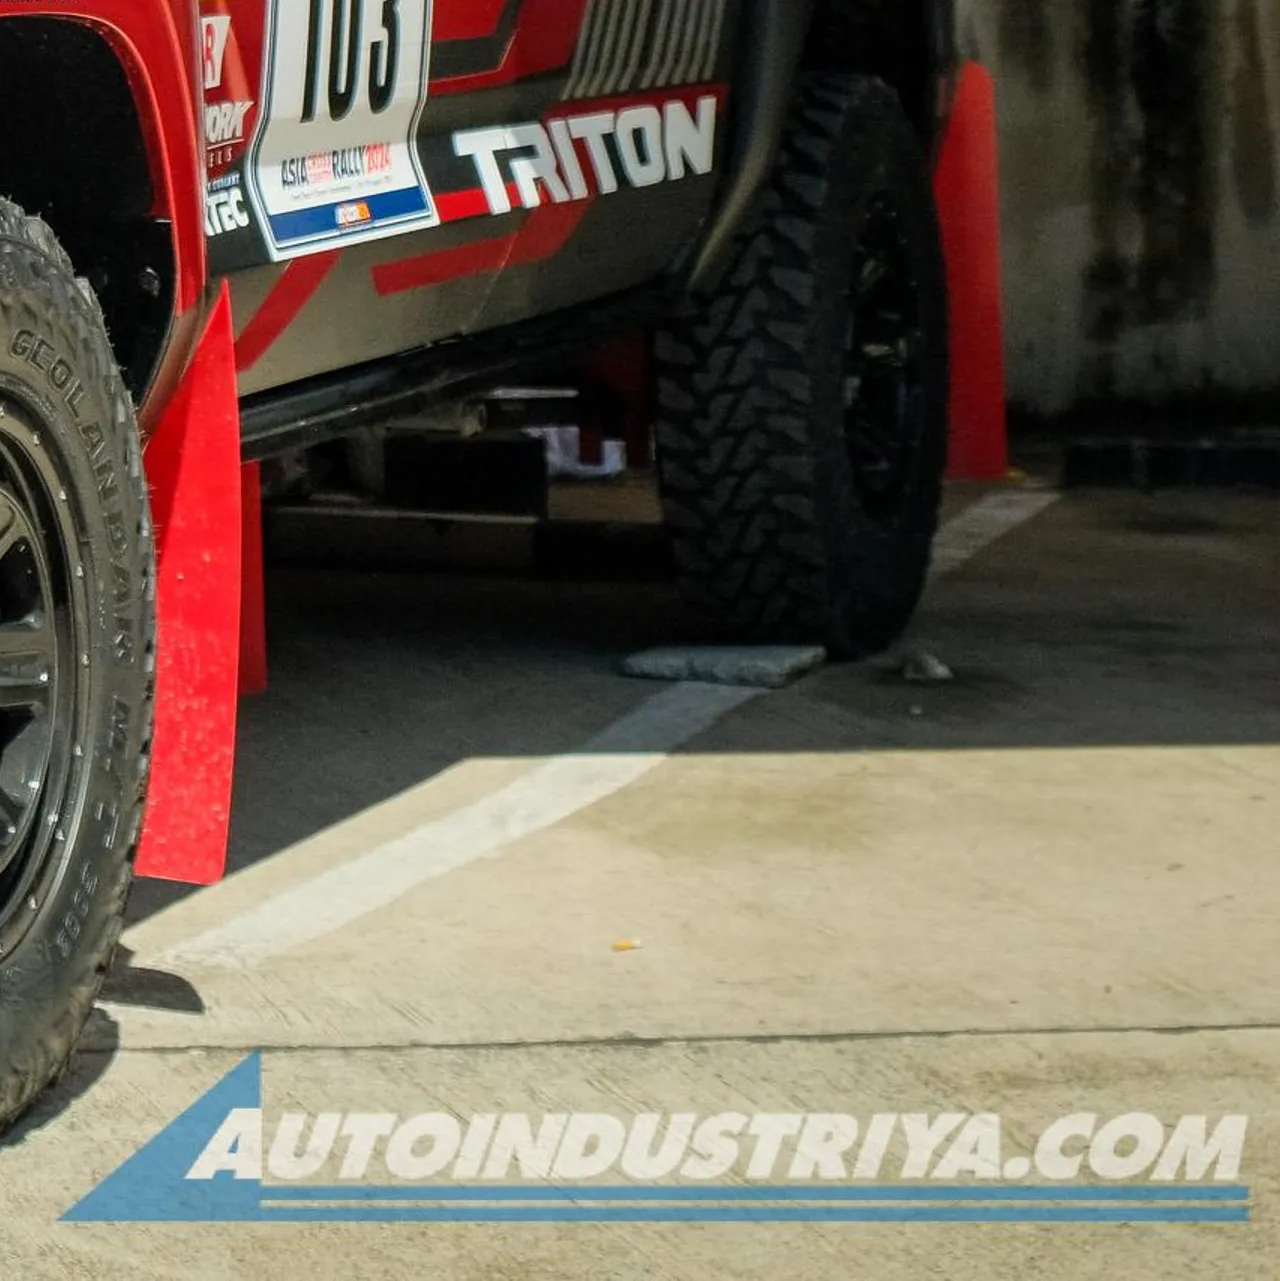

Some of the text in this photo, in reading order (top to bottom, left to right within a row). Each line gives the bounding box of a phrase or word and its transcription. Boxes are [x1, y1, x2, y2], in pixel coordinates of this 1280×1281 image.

[280, 156, 309, 189] ASIA
[332, 145, 366, 181] RALLY
[452, 95, 718, 215] TRITON
